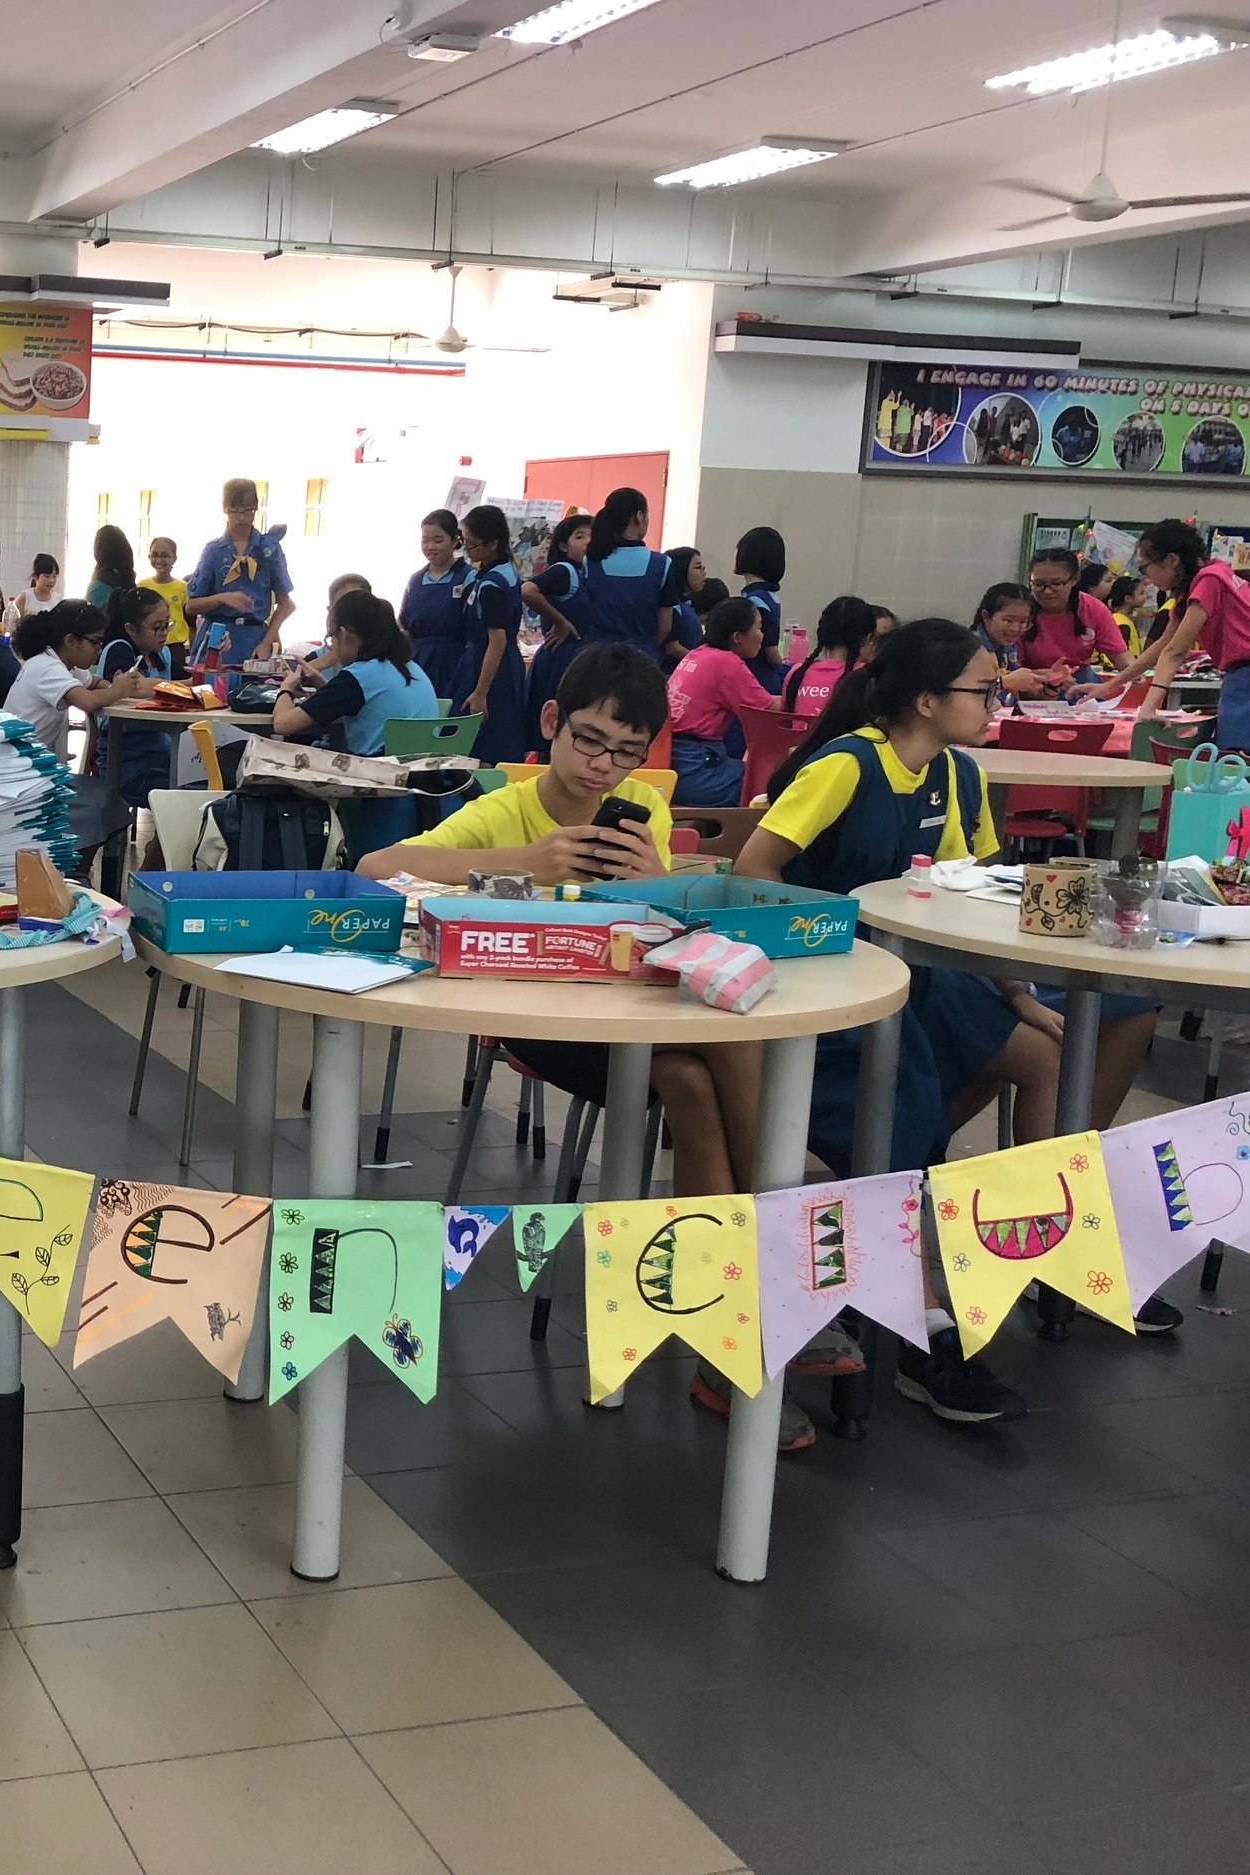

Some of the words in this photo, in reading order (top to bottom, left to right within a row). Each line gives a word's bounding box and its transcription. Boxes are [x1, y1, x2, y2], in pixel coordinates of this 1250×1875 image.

[917, 368, 927, 384] I
[930, 370, 1002, 387] ENGAGE
[1006, 373, 1028, 388] IN
[1033, 374, 1059, 389] 60
[1062, 375, 1139, 395] MINUTES
[1143, 380, 1169, 396] OF
[1187, 400, 1231, 417] DAYS
[310, 909, 366, 943] One
[341, 917, 391, 930] PAPER
[789, 913, 832, 948] One
[813, 919, 848, 934] PAPER
[545, 936, 596, 951] FORTUNE
[460, 960, 479, 968] Super
